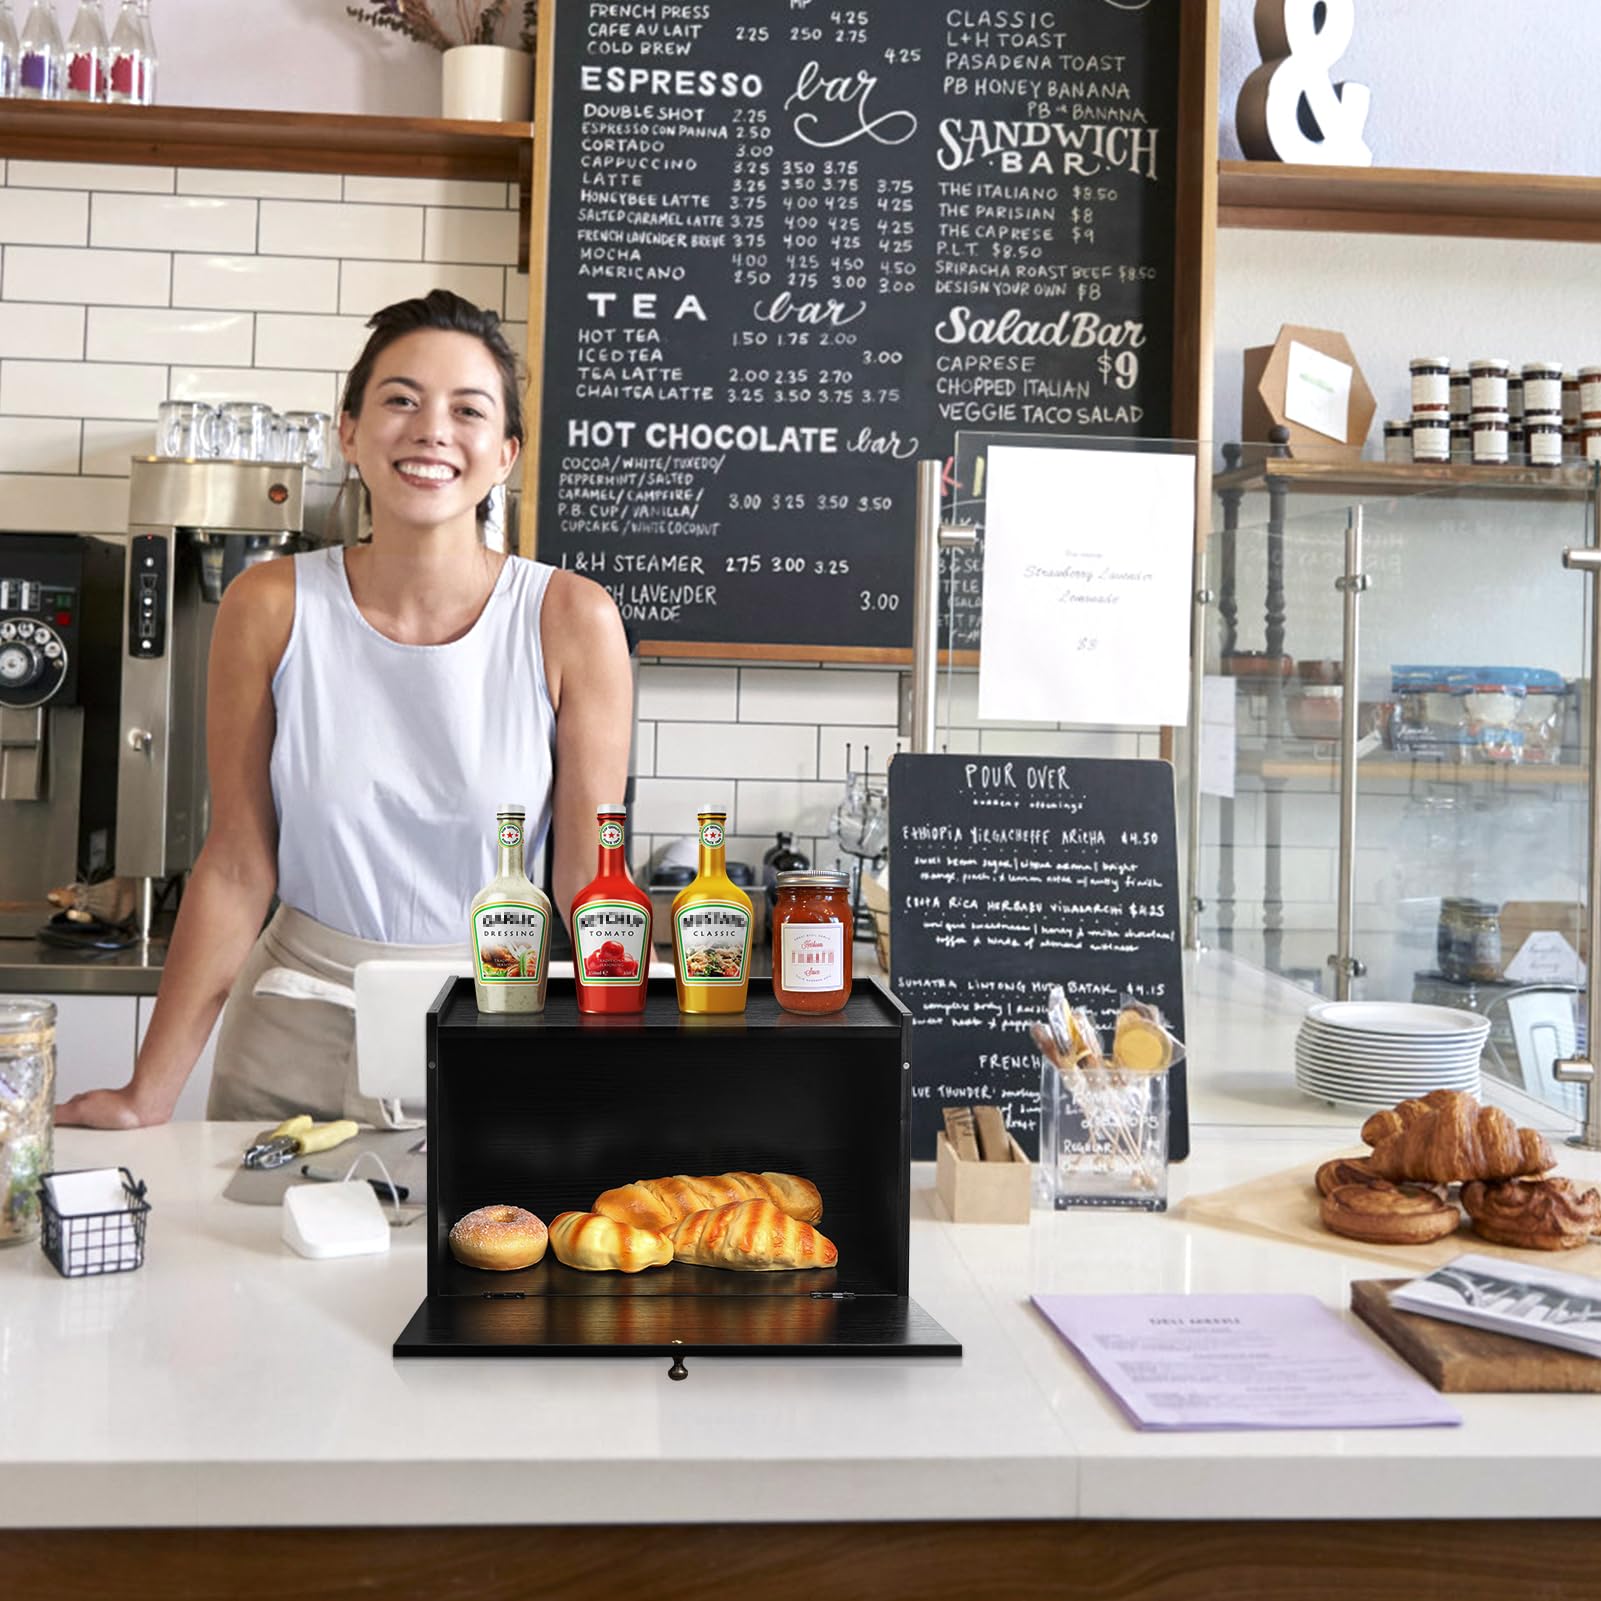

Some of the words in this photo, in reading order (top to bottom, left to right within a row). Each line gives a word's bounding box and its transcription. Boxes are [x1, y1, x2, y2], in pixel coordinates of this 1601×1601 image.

[589, 3, 656, 20] FRENCH
[661, 5, 711, 20] PRESS
[946, 9, 1055, 29] CLASSIC
[588, 22, 631, 37] CAFE
[635, 23, 659, 37] AU
[663, 24, 703, 39] LAIT
[947, 32, 989, 48] L+H
[997, 33, 1067, 49] TOAST
[587, 41, 633, 55] COLD
[640, 42, 691, 56] BREW
[945, 52, 1052, 71] PASADENA
[1058, 55, 1127, 72] TOAST
[580, 65, 762, 98] ESPRESSO
[943, 76, 968, 95] PB
[975, 78, 1041, 98] HONEY
[1048, 80, 1131, 100] BANANA
[583, 103, 654, 119] DOUBLE
[657, 107, 705, 123] SHOT
[732, 109, 767, 124] 2.25
[1027, 101, 1051, 120] PB
[1072, 103, 1148, 124] BANANA
[581, 122, 650, 135] ESPRESSO
[652, 124, 676, 137] CON
[679, 125, 728, 140] PANNA
[581, 138, 665, 153] CORTADO
[735, 144, 774, 158] 3.00
[936, 118, 1159, 180] SANDWICH
[580, 155, 697, 171] CAPPUCCINO
[733, 161, 770, 176] 3.25
[782, 160, 815, 175] 3.50
[823, 160, 858, 175] 3.75
[1001, 150, 1100, 176] BAR
[582, 172, 643, 187] LATTE
[732, 178, 767, 193] 3.25
[876, 179, 914, 194] 3.75
[937, 181, 973, 197] THE
[976, 183, 1058, 201] ITALIANO
[580, 189, 657, 206] HONEYBEE
[662, 194, 710, 208] LATTE
[577, 208, 626, 222] SALTED
[626, 211, 683, 227] CARAMEL
[687, 215, 725, 228] LATTE
[938, 203, 969, 218] THE
[975, 204, 1056, 221] PARISIAN
[1071, 207, 1093, 224] $8
[577, 229, 624, 243] FRENCH
[626, 231, 688, 248] LAVENDER
[691, 234, 726, 248] BREVE
[939, 224, 970, 238] THE
[975, 225, 1054, 241] CAPRESE
[1072, 226, 1094, 244] $9
[580, 248, 642, 262] MOCHA
[992, 242, 1043, 259] $8.50
[577, 263, 686, 281] AMERICANO
[935, 261, 1011, 277] SRIRACHA
[1016, 265, 1068, 280] ROAST
[1072, 266, 1113, 279] BEEF
[935, 280, 989, 295] DESIGN
[993, 281, 1029, 296] YOUR
[1034, 283, 1067, 296] OWN
[1078, 283, 1101, 301] $8
[587, 292, 708, 321] TEA
[753, 291, 867, 326] bar
[578, 328, 616, 344] HOT
[623, 328, 660, 343] TEA
[935, 306, 1071, 347] Salad
[1070, 312, 1146, 348] Bar
[578, 348, 625, 363] ICED
[627, 348, 663, 363] TEA
[862, 351, 902, 364] 3.00
[577, 366, 616, 381] TEA
[622, 367, 683, 382] LATTE
[729, 369, 769, 382] 2.00
[936, 356, 1036, 372] CAPRESE
[1097, 349, 1138, 390] $9
[575, 384, 619, 399] CHAI
[625, 385, 655, 399] TEA
[658, 387, 714, 401] LATTE
[818, 389, 853, 404] 3.75
[936, 378, 1016, 396] CHOPPED
[1024, 379, 1090, 400] ITALIAN
[938, 402, 1017, 421] VEGGIE
[1022, 404, 1072, 423] TACO
[1076, 406, 1144, 424] SALAD
[568, 420, 636, 448] HOT
[645, 423, 838, 453] CHOCOLATE
[846, 427, 919, 459] bar
[728, 494, 762, 509] 3.00
[858, 496, 892, 511] 3.50
[613, 555, 705, 574] STEAMER
[630, 585, 717, 605] LAVENDER
[860, 591, 900, 611] 3.00
[965, 762, 1016, 788] POUR
[1026, 765, 1070, 790] OVER
[897, 976, 957, 989] SUMATRA
[978, 1053, 1041, 1070] FRENCH
